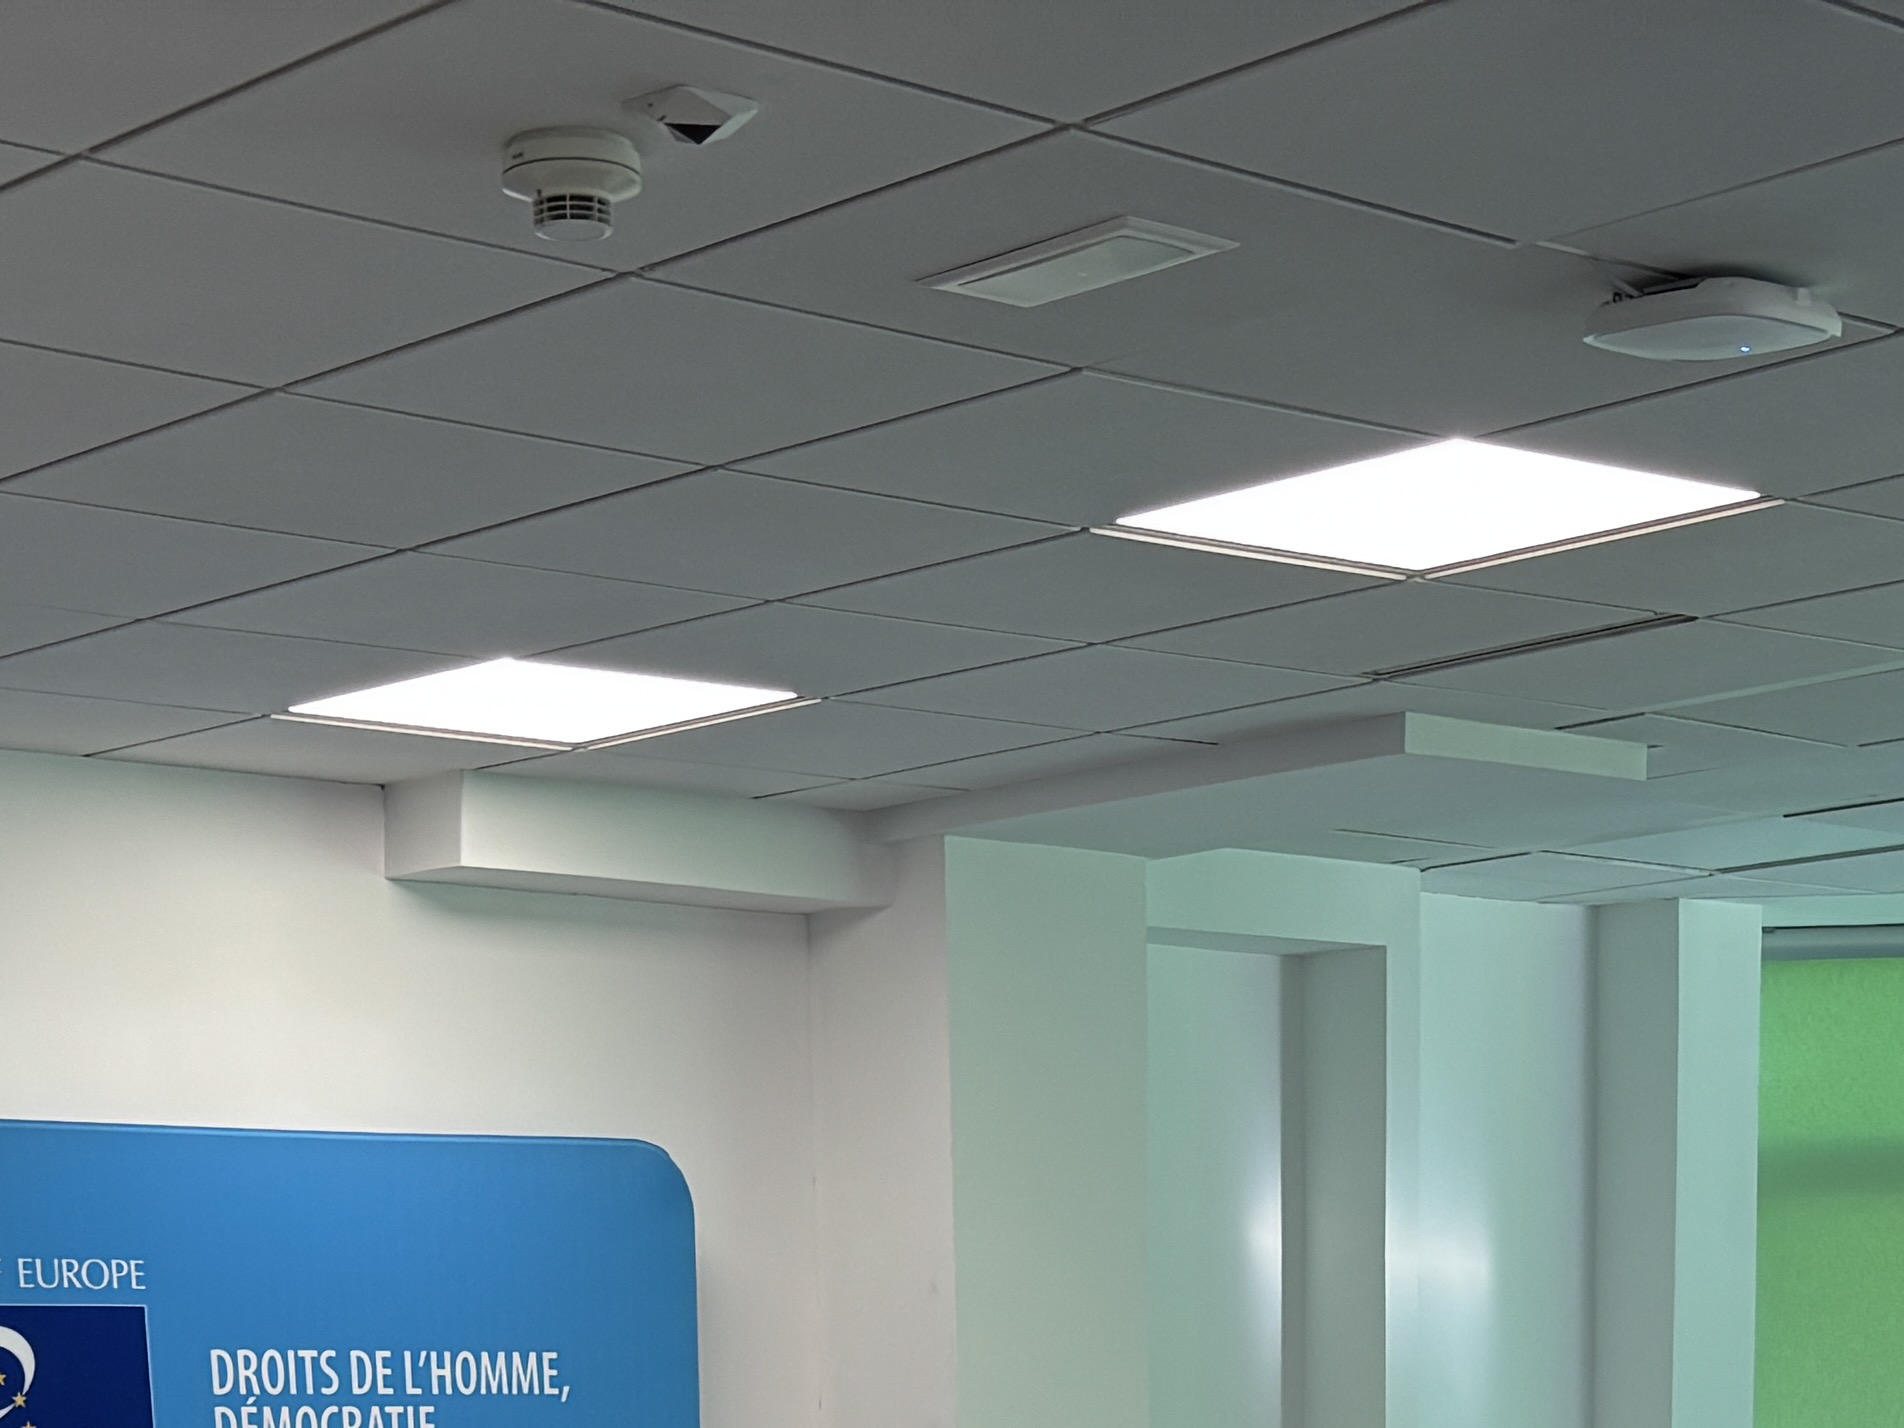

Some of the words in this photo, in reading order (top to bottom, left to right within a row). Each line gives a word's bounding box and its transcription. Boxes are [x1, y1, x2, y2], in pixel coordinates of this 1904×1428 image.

[18, 1259, 145, 1289] EUROPE
[211, 1349, 339, 1395] DROITS
[350, 1350, 393, 1394] DE
[404, 1351, 569, 1402] L'HOMME,
